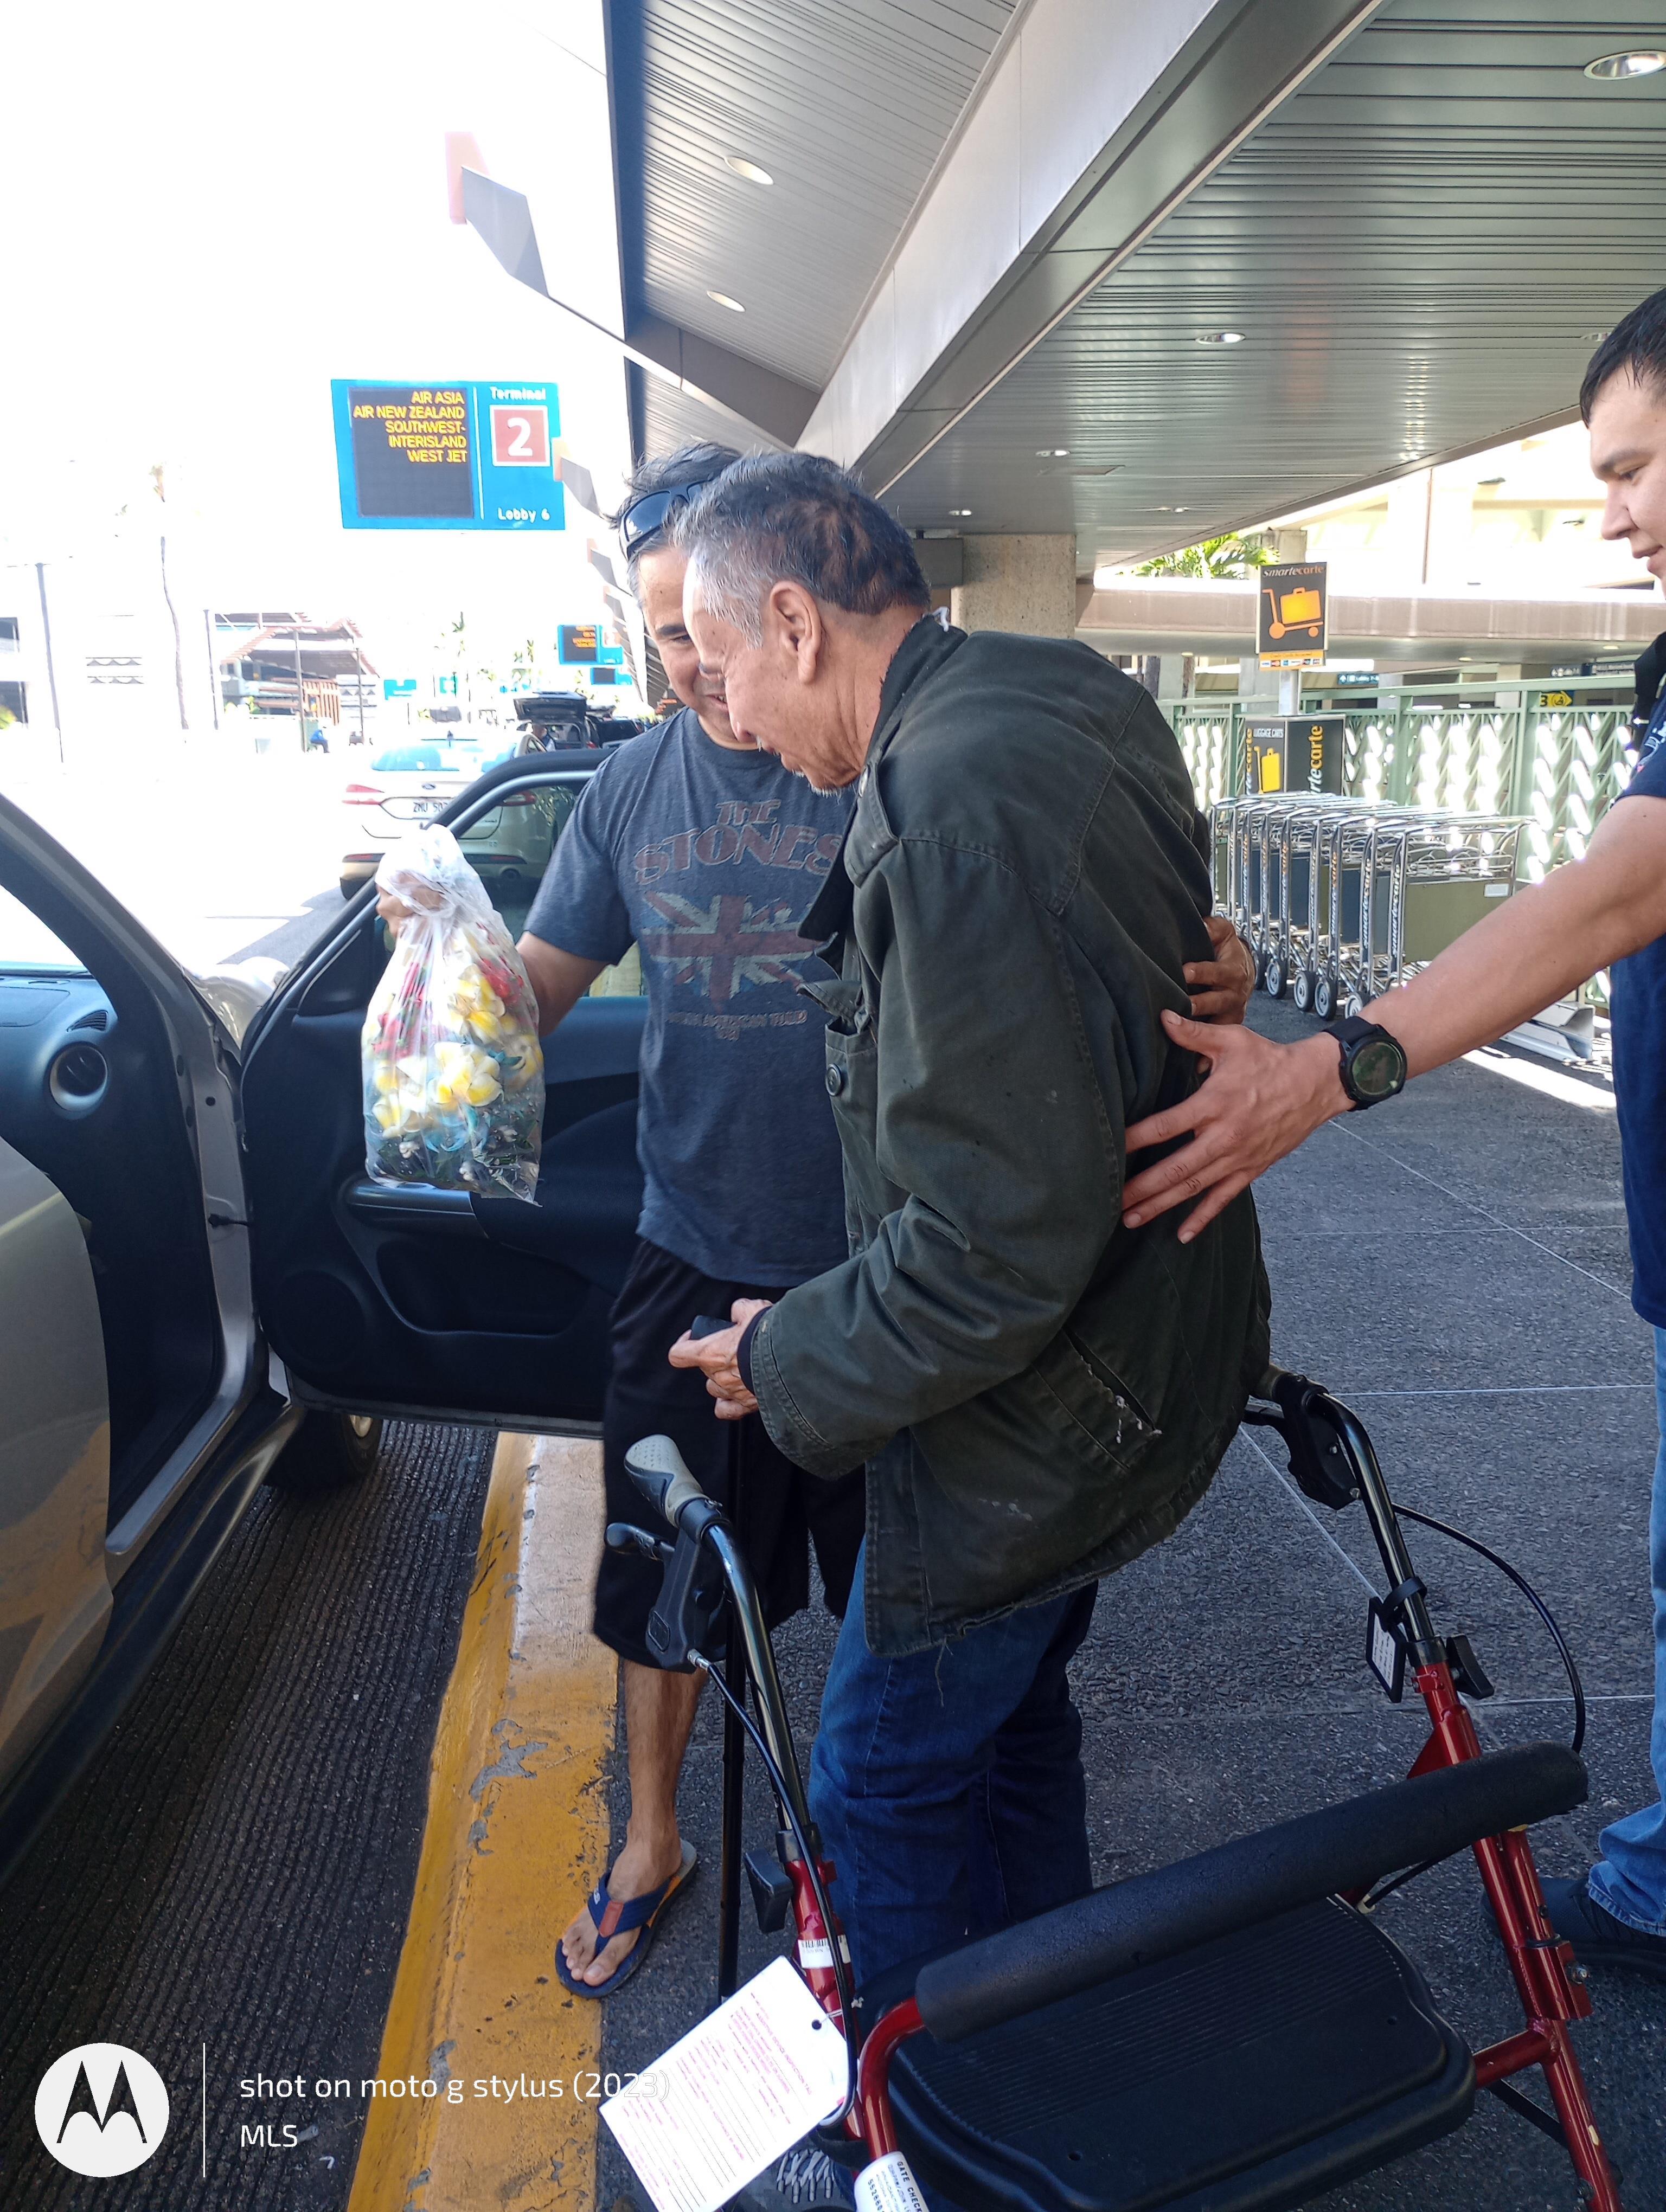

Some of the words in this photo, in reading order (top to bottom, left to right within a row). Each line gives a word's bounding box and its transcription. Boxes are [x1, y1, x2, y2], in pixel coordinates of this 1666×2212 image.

[411, 390, 433, 404] AIR
[434, 391, 465, 405] ASIA
[489, 386, 546, 401] Terminal
[353, 405, 375, 419] AIR
[375, 405, 407, 419] NEW
[408, 405, 465, 419] ZEALAND
[384, 420, 466, 434] SOUTHWEST-
[388, 434, 467, 448] INTERISLAND
[507, 417, 533, 456] 2
[407, 449, 444, 462] WEST
[446, 449, 468, 462] JET
[498, 507, 536, 524] Lobby
[541, 508, 551, 521] 6
[1263, 565, 1324, 577] smartecarte
[715, 799, 781, 825] THE
[633, 823, 843, 885] STONES
[897, 2161, 910, 2182] GATE
